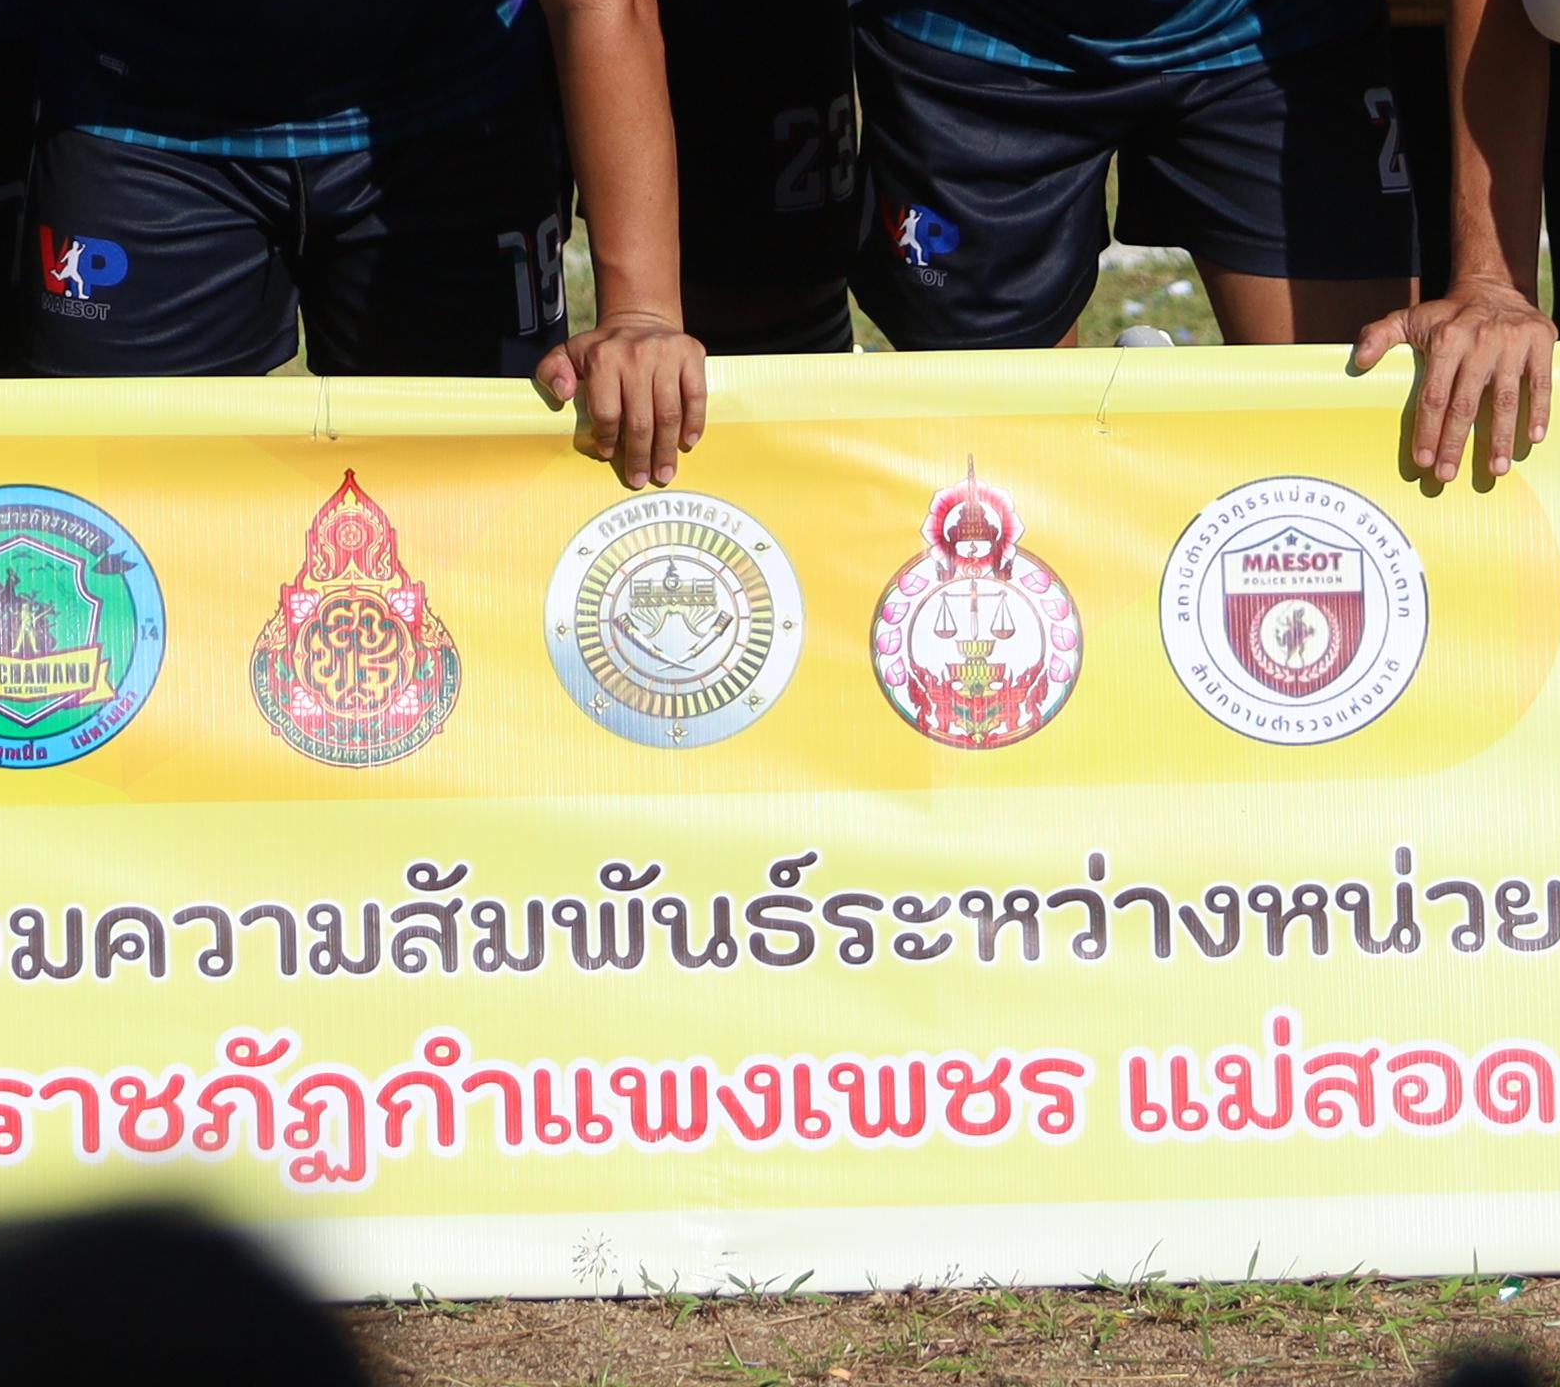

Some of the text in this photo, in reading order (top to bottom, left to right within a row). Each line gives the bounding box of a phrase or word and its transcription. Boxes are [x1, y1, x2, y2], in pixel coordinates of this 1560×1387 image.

[597, 498, 744, 540] กรมทางหลวง
[1241, 551, 1343, 573] MAESOT
[1243, 576, 1344, 586] POLICE STATION
[1191, 657, 1402, 734] สำนักงานตำรวจแห่งชาติ
[1128, 1012, 1558, 1137] แม่สอด
